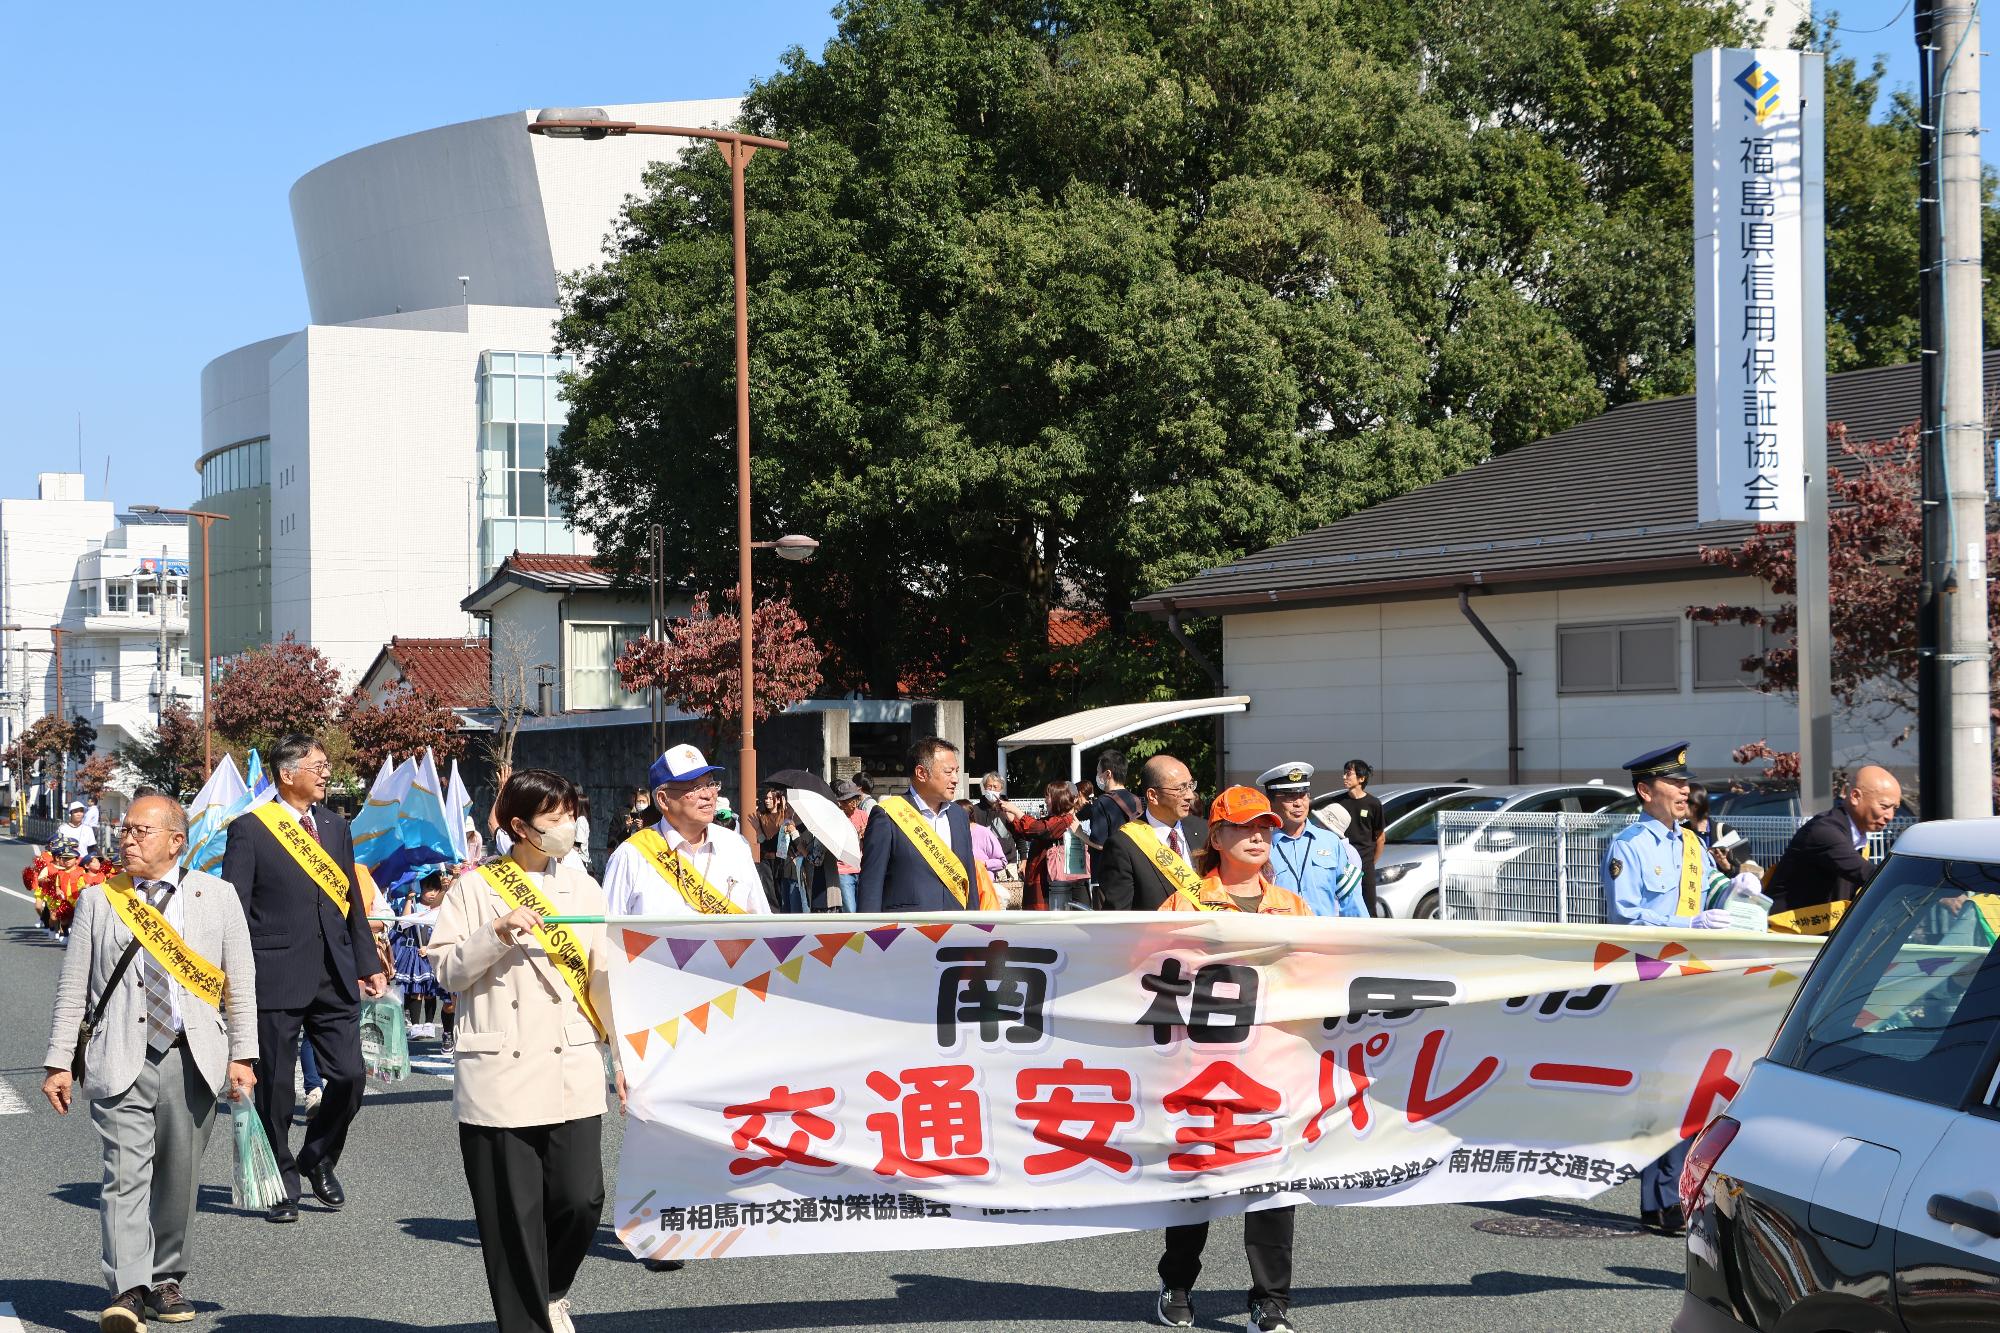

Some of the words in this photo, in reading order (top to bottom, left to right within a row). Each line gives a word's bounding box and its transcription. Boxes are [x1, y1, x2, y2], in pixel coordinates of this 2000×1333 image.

[1740, 136, 1779, 512] 福島県信用保証協会
[660, 1193, 952, 1232] 南相馬市交通対策協議会
